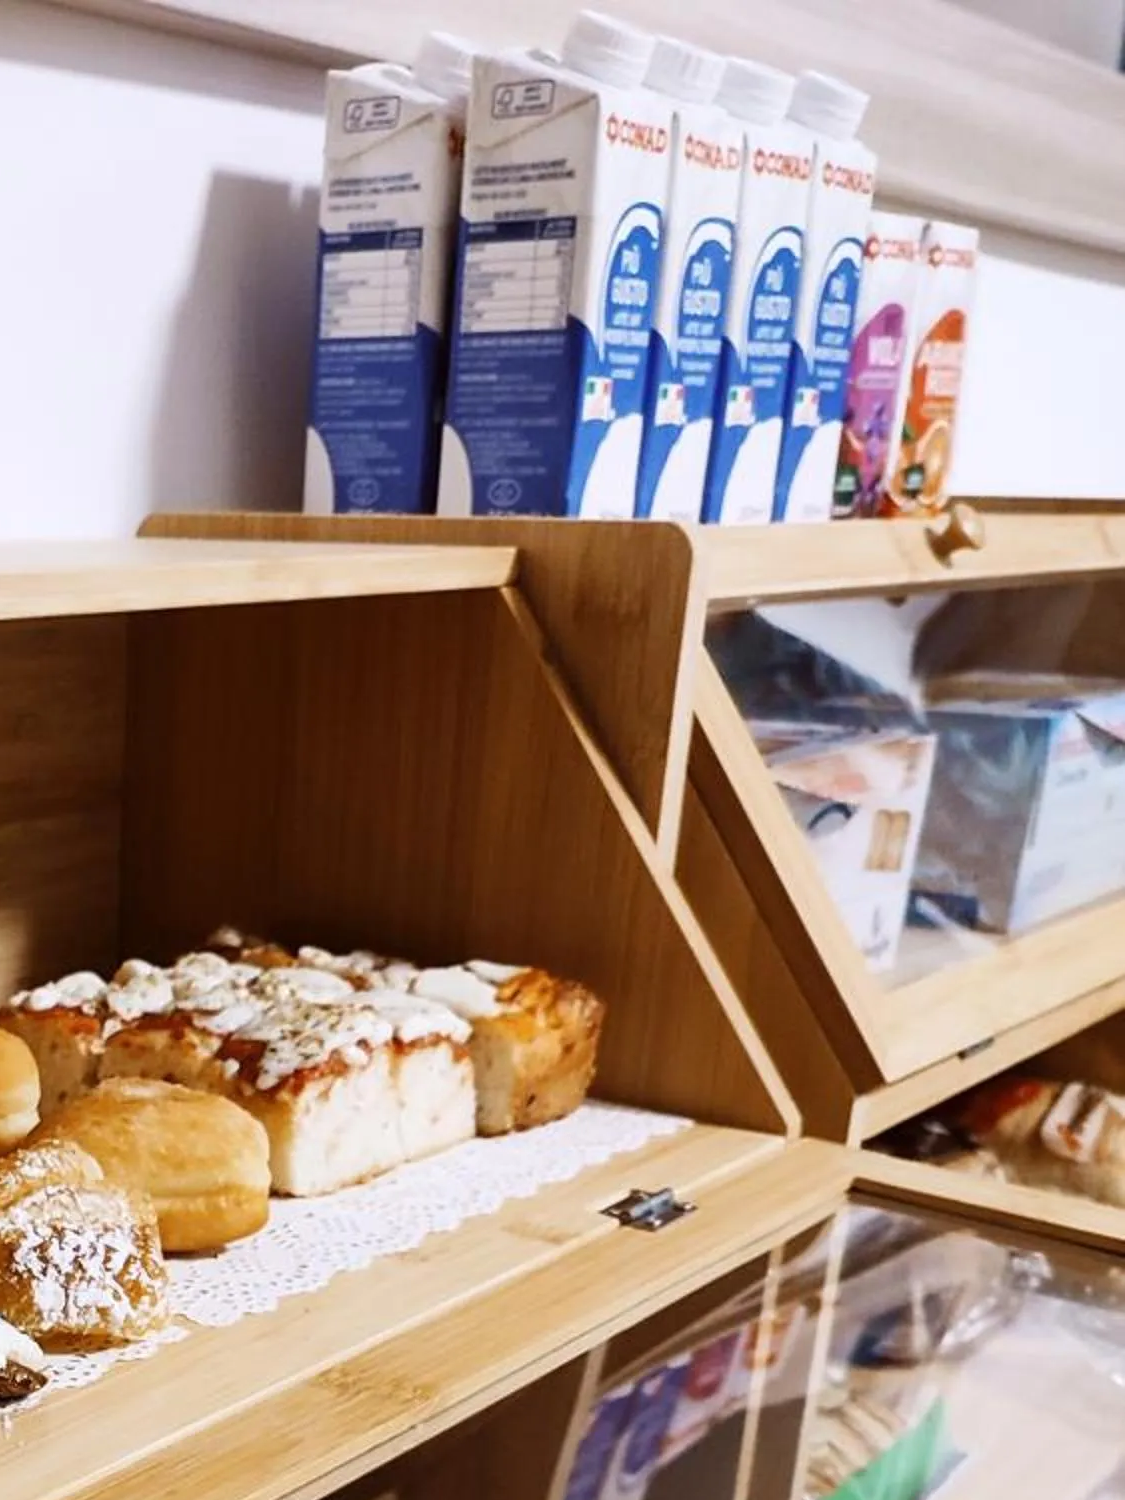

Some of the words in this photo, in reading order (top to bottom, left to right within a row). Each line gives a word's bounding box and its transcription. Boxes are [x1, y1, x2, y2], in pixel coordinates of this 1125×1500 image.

[621, 118, 668, 154] CONAD
[764, 151, 812, 180] CONAD
[833, 165, 873, 194] CONAD
[621, 243, 641, 275] PIÙ
[691, 257, 712, 287] PIÙ
[611, 276, 649, 306] GUSTO
[764, 264, 784, 292] PIÙ
[683, 288, 721, 318] GUSTO
[754, 295, 792, 321] GUSTO
